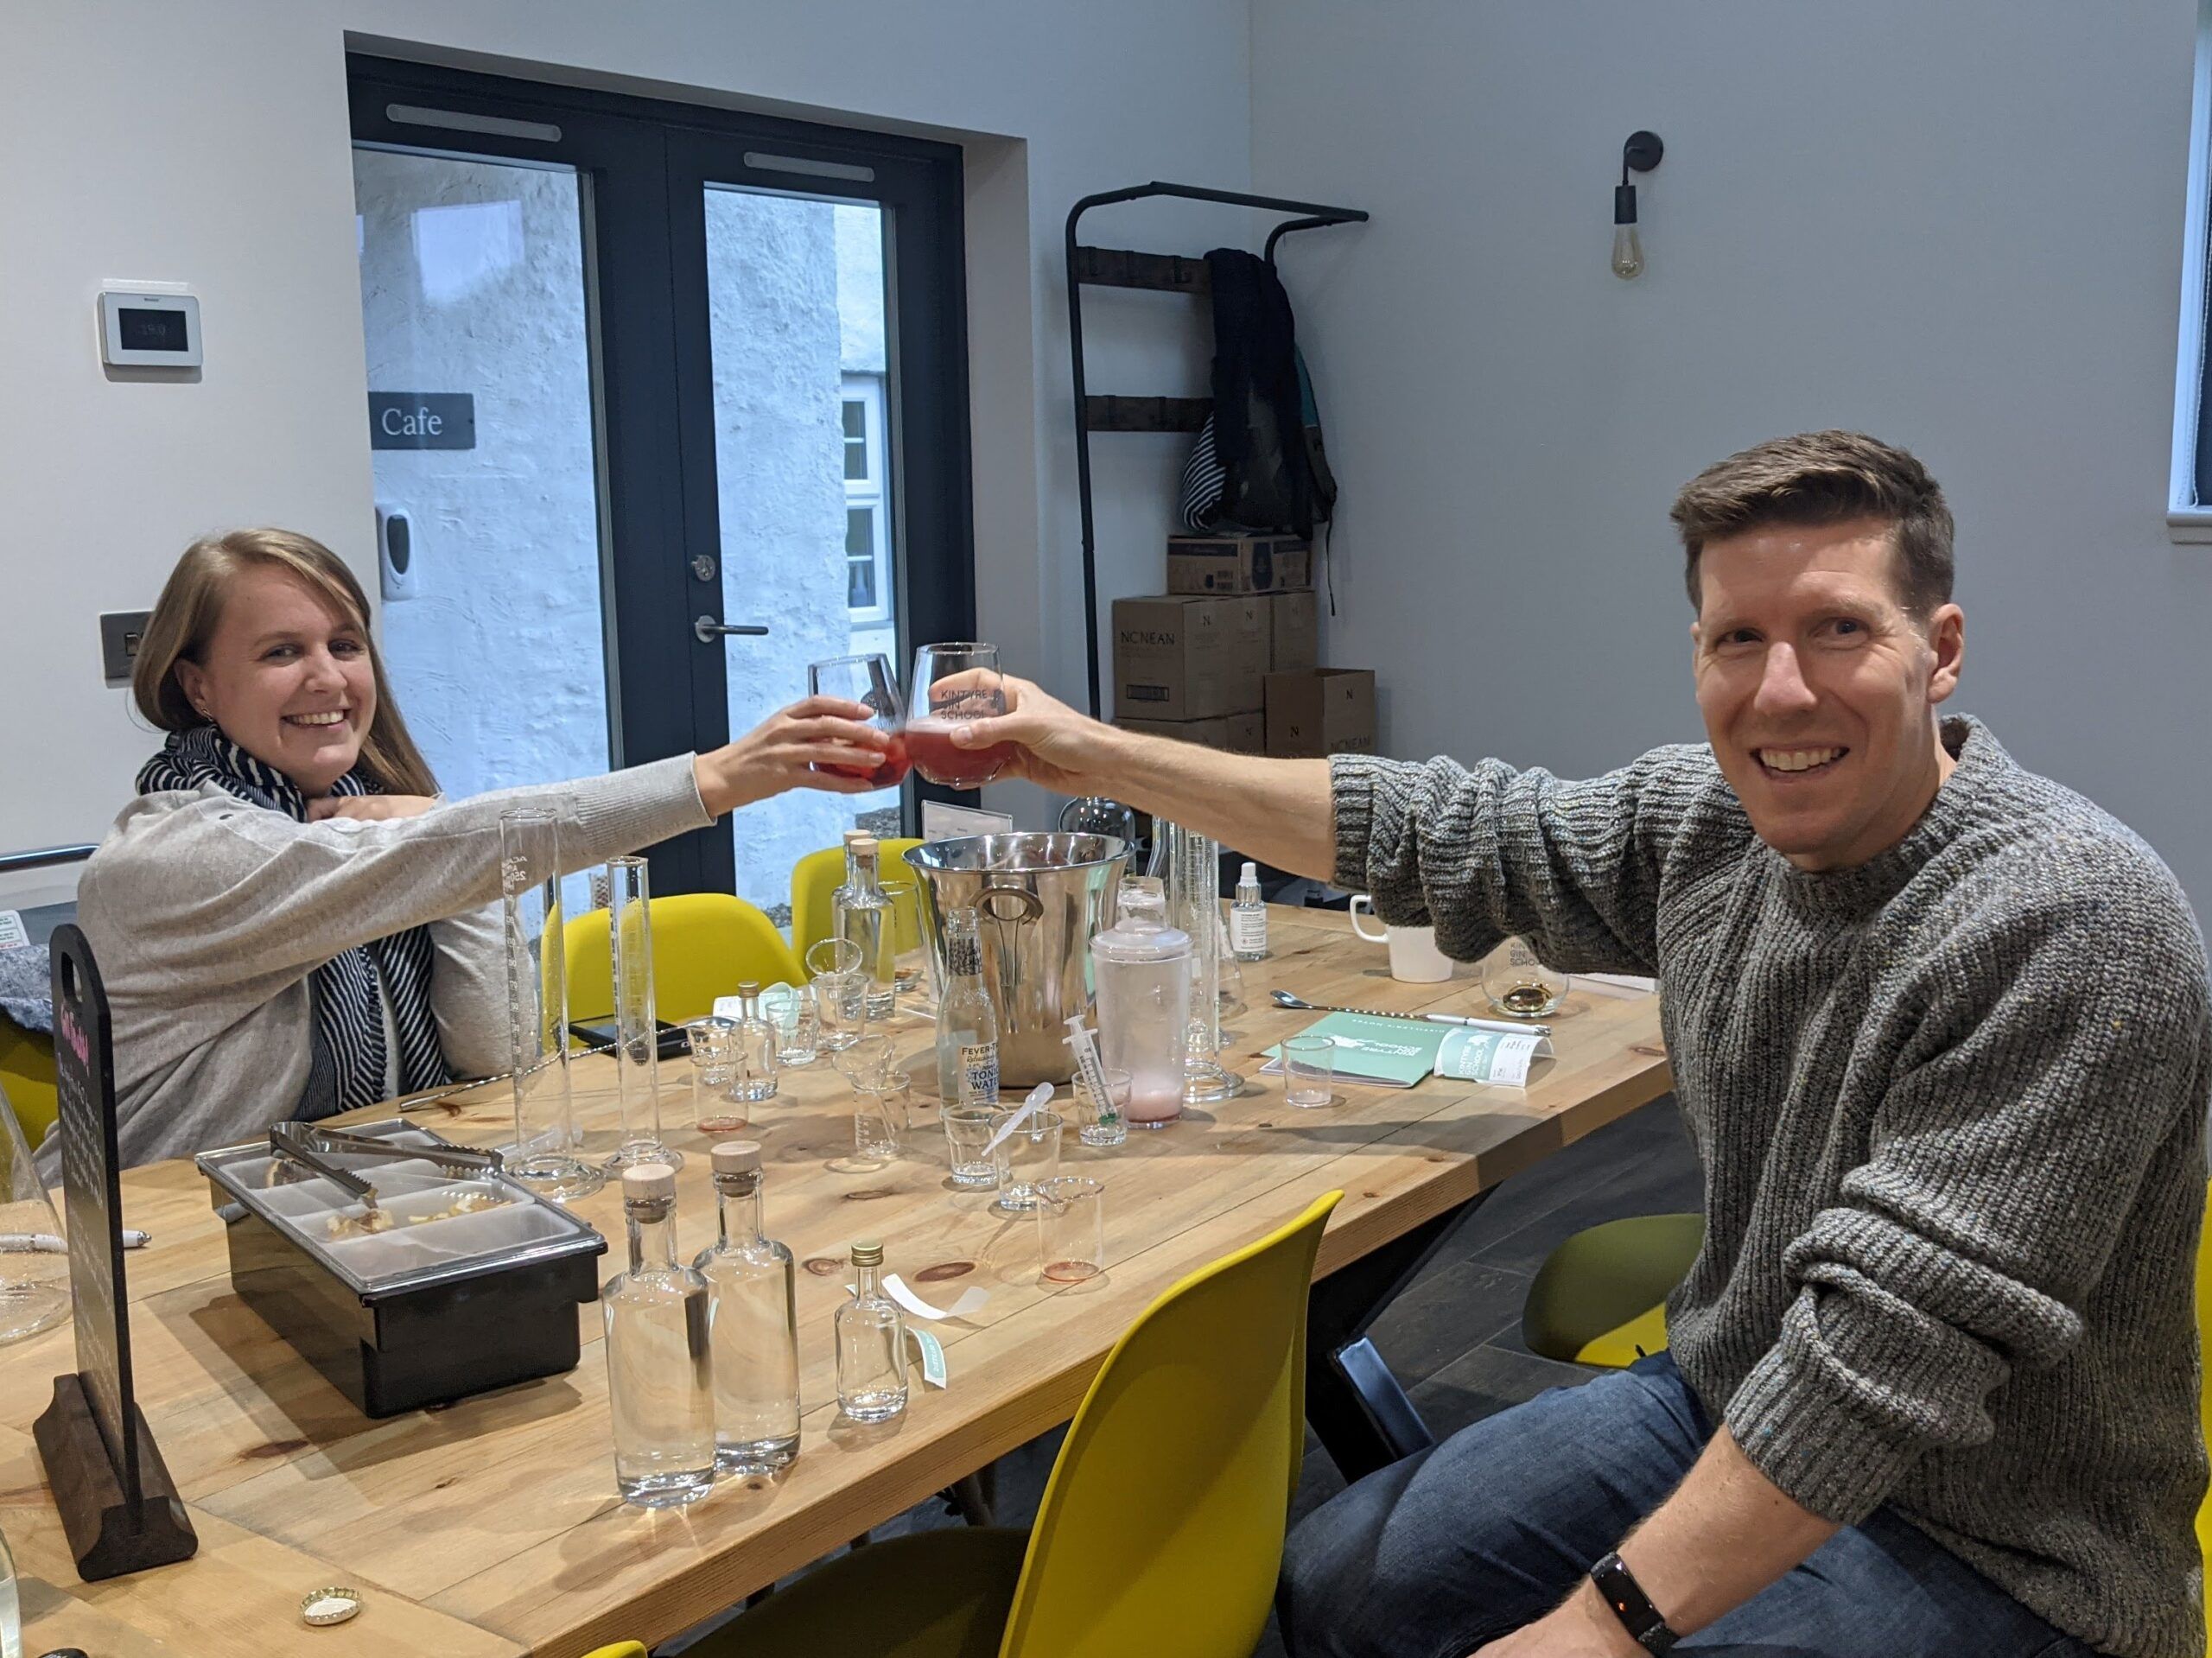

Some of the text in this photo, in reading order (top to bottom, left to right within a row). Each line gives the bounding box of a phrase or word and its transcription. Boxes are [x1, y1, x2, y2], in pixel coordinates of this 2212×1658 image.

[382, 406, 442, 435] Cafe
[1203, 615, 1211, 626] N
[1246, 610, 1254, 621] N
[941, 689, 988, 700] KINTYRE
[1346, 689, 1354, 700] N
[1290, 726, 1299, 738] N
[1510, 958, 1536, 967] SCHO
[962, 1042, 999, 1055] FEVER-T
[971, 1077, 999, 1090] WATE
